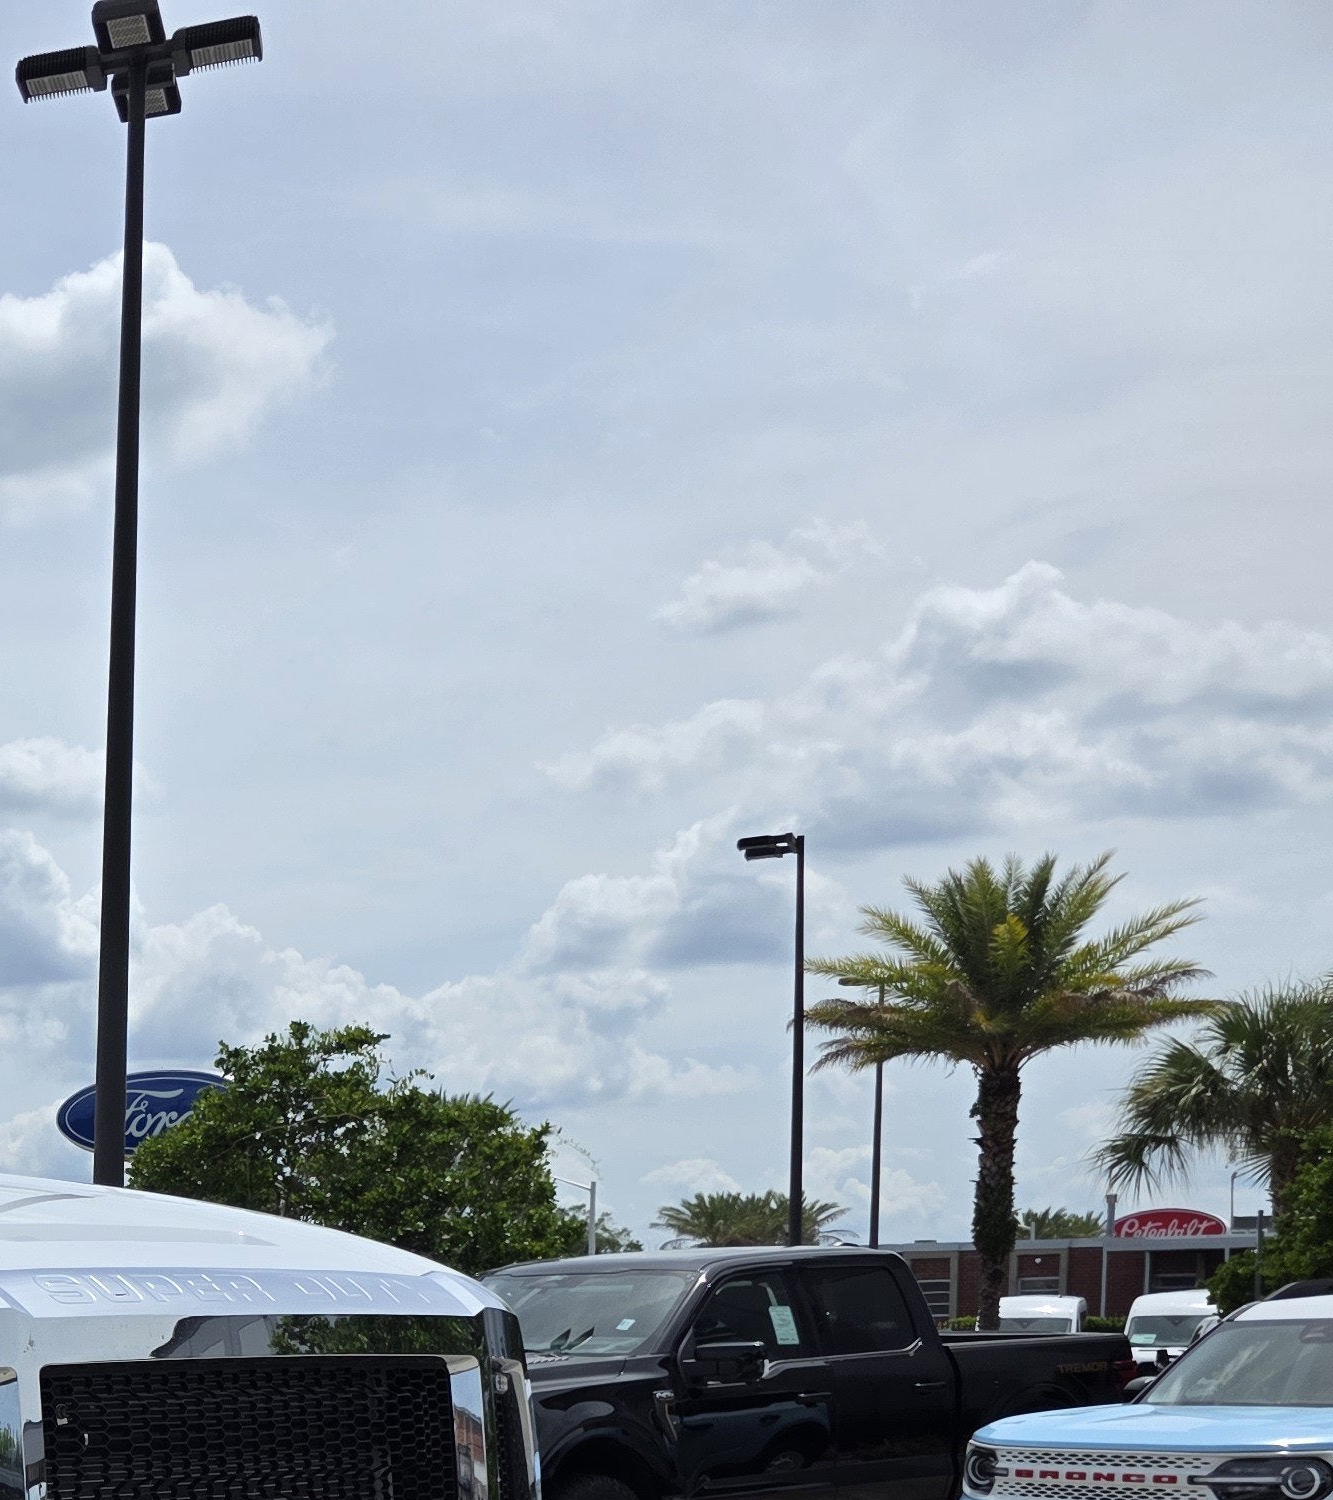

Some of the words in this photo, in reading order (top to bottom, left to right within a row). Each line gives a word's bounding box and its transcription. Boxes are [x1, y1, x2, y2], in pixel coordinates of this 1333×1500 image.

[1120, 1218, 1216, 1238] Peterbilt
[33, 1273, 277, 1304] SUPER
[1015, 1469, 1178, 1484] BRONCO
